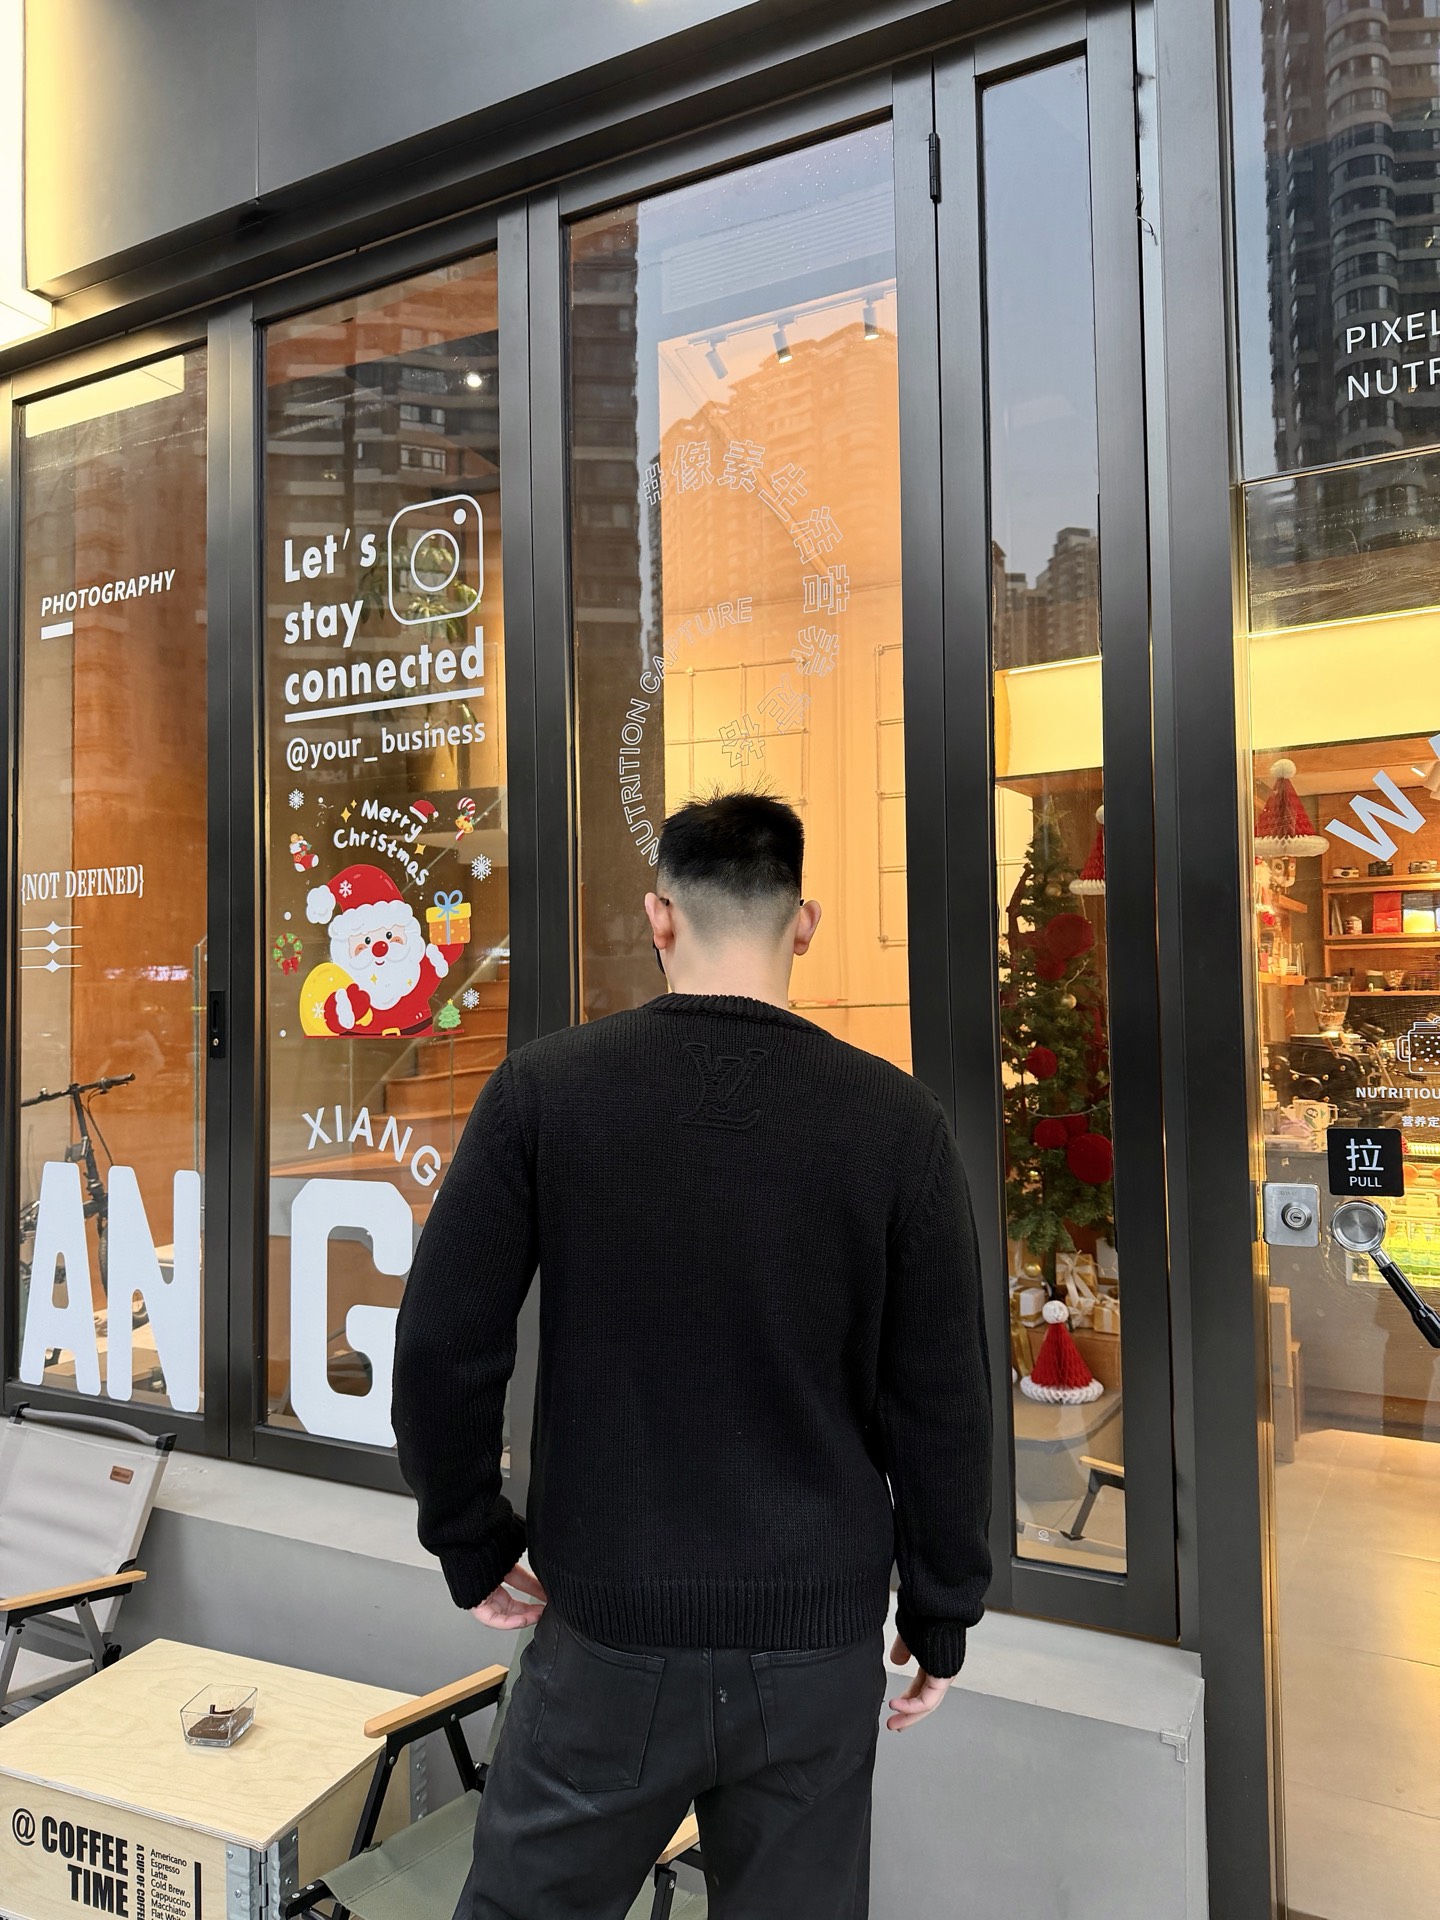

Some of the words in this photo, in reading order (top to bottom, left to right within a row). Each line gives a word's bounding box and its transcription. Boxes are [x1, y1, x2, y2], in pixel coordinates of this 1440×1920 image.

[1346, 309, 1440, 354] PIXEL
[41, 569, 176, 617] PHOTOGRAPHY
[284, 600, 364, 648] stay
[284, 625, 484, 705] connected
[619, 698, 660, 867] NUTRITION
[640, 597, 753, 694] CAPTURE
[361, 799, 423, 843] Merry
[333, 826, 430, 886] Christmas
[1345, 1138, 1384, 1172] 拉
[1349, 1176, 1382, 1188] PULL
[12, 1808, 36, 1846] @
[41, 1815, 128, 1876] COFFEE
[136, 1844, 145, 1852] A
[136, 1853, 145, 1874] CUP
[150, 1848, 188, 1867] Americano
[150, 1858, 181, 1875] Espresso
[136, 1875, 145, 1888] OF
[150, 1868, 168, 1881] Latte
[150, 1879, 167, 1891] Cold
[168, 1884, 186, 1897] Brew
[67, 1863, 129, 1918] TIME
[150, 1888, 191, 1909] Cappuccino
[151, 1898, 187, 1917] Macchiato
